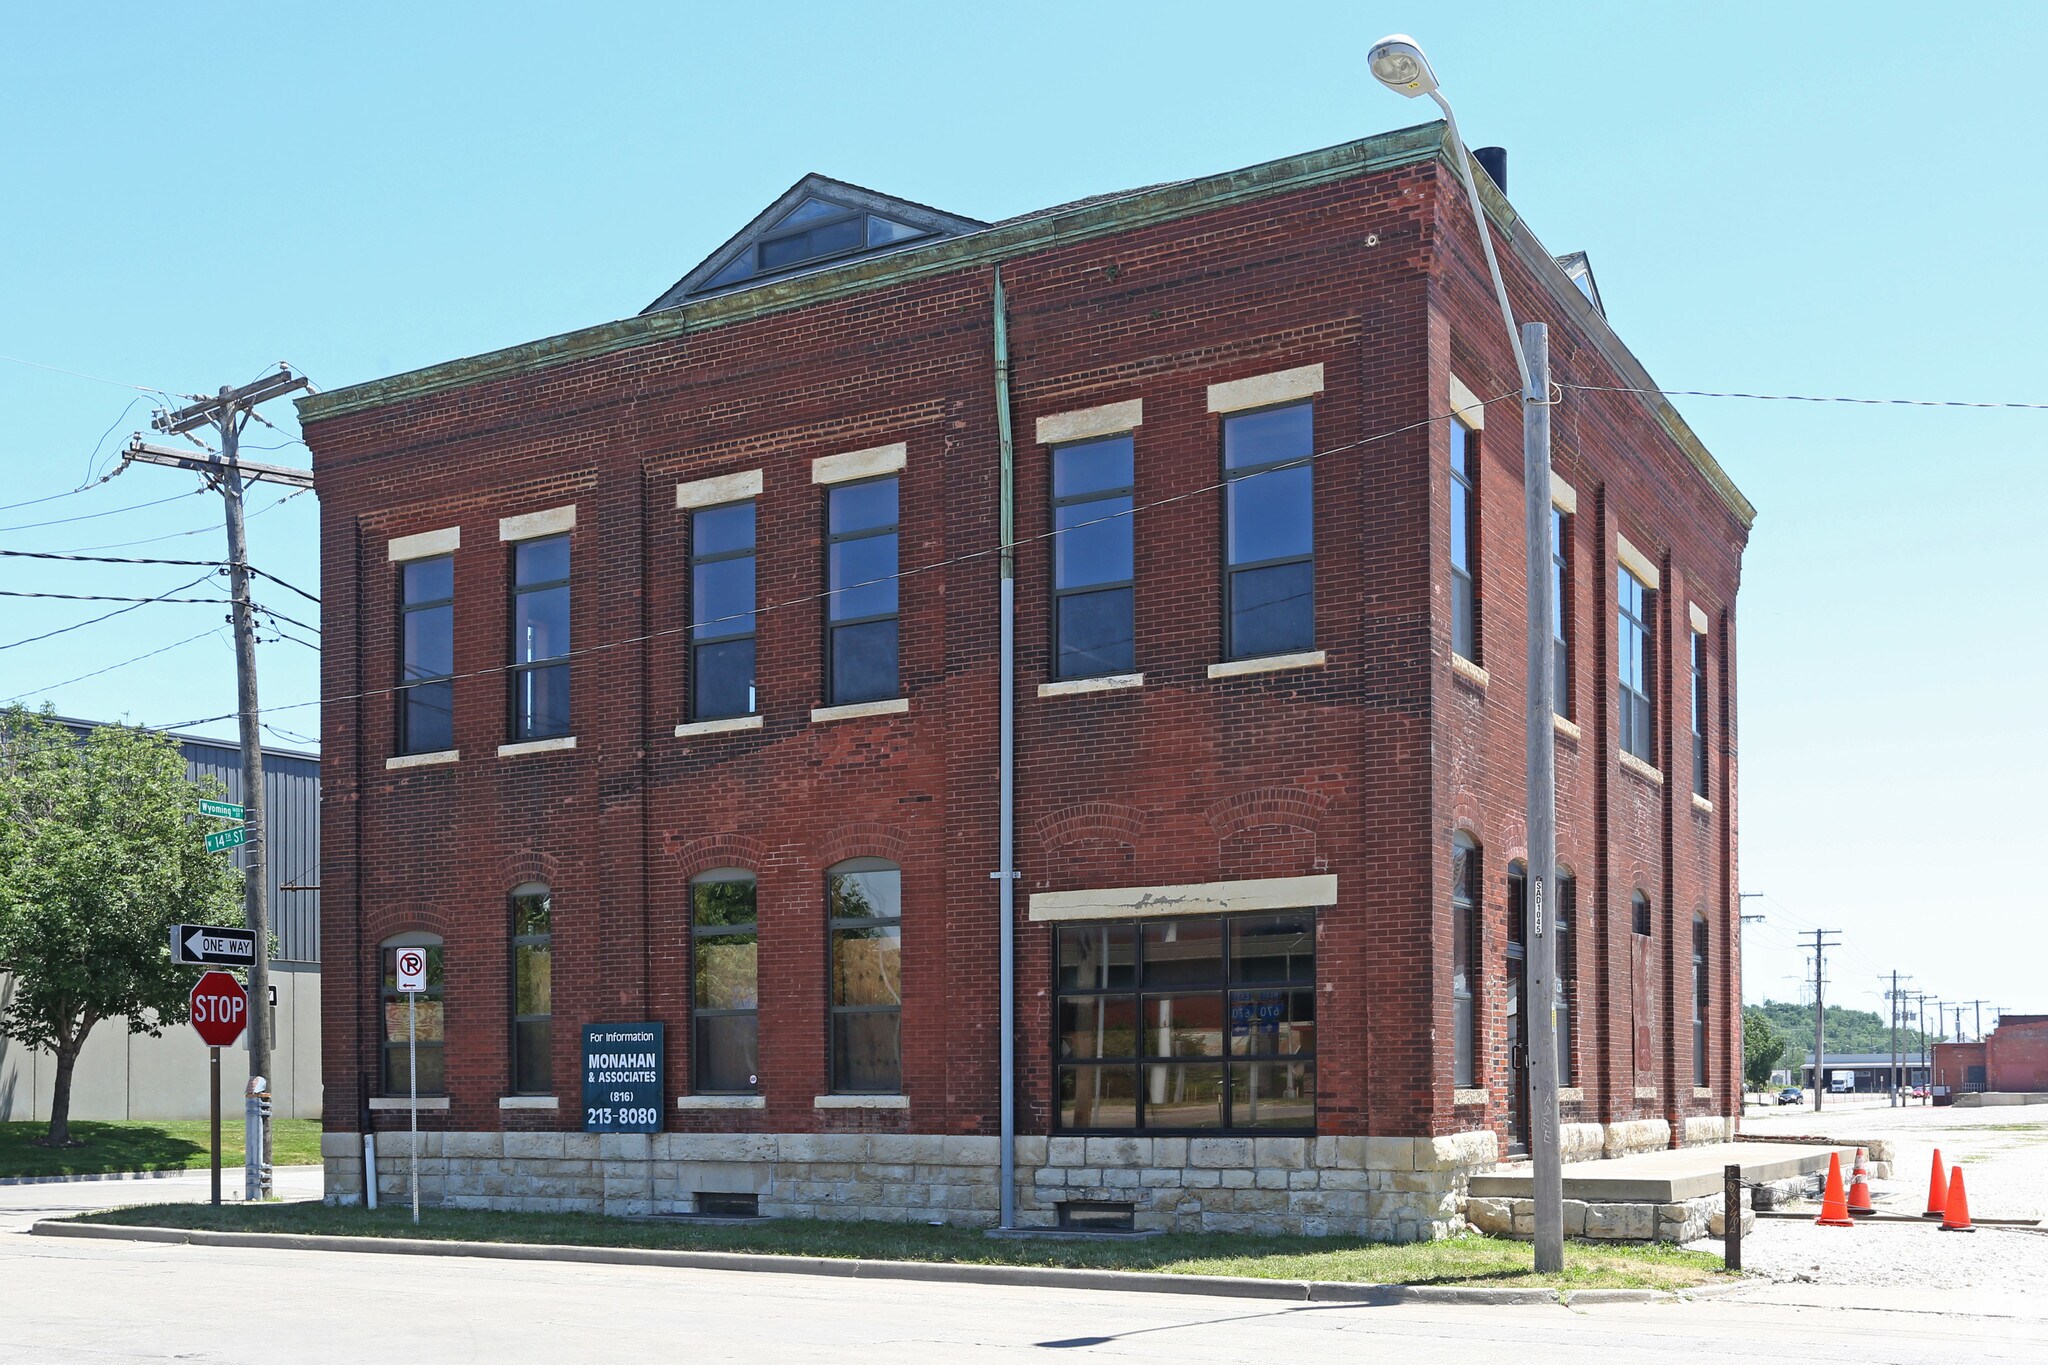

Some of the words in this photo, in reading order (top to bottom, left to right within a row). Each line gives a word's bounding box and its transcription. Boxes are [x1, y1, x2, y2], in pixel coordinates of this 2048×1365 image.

[202, 802, 232, 818] Wyoming
[215, 832, 233, 848] 14TH
[233, 829, 244, 843] ST
[203, 938, 224, 952] ONE
[229, 940, 250, 954] WAY
[195, 994, 244, 1023] STOP
[590, 1033, 603, 1042] For
[606, 1032, 654, 1042] Information
[588, 1053, 656, 1069] MONAHAN
[588, 1072, 595, 1083] &
[598, 1071, 657, 1083] ASSOCIATES
[610, 1091, 634, 1102] (816)
[588, 1107, 657, 1124] 213-8080
